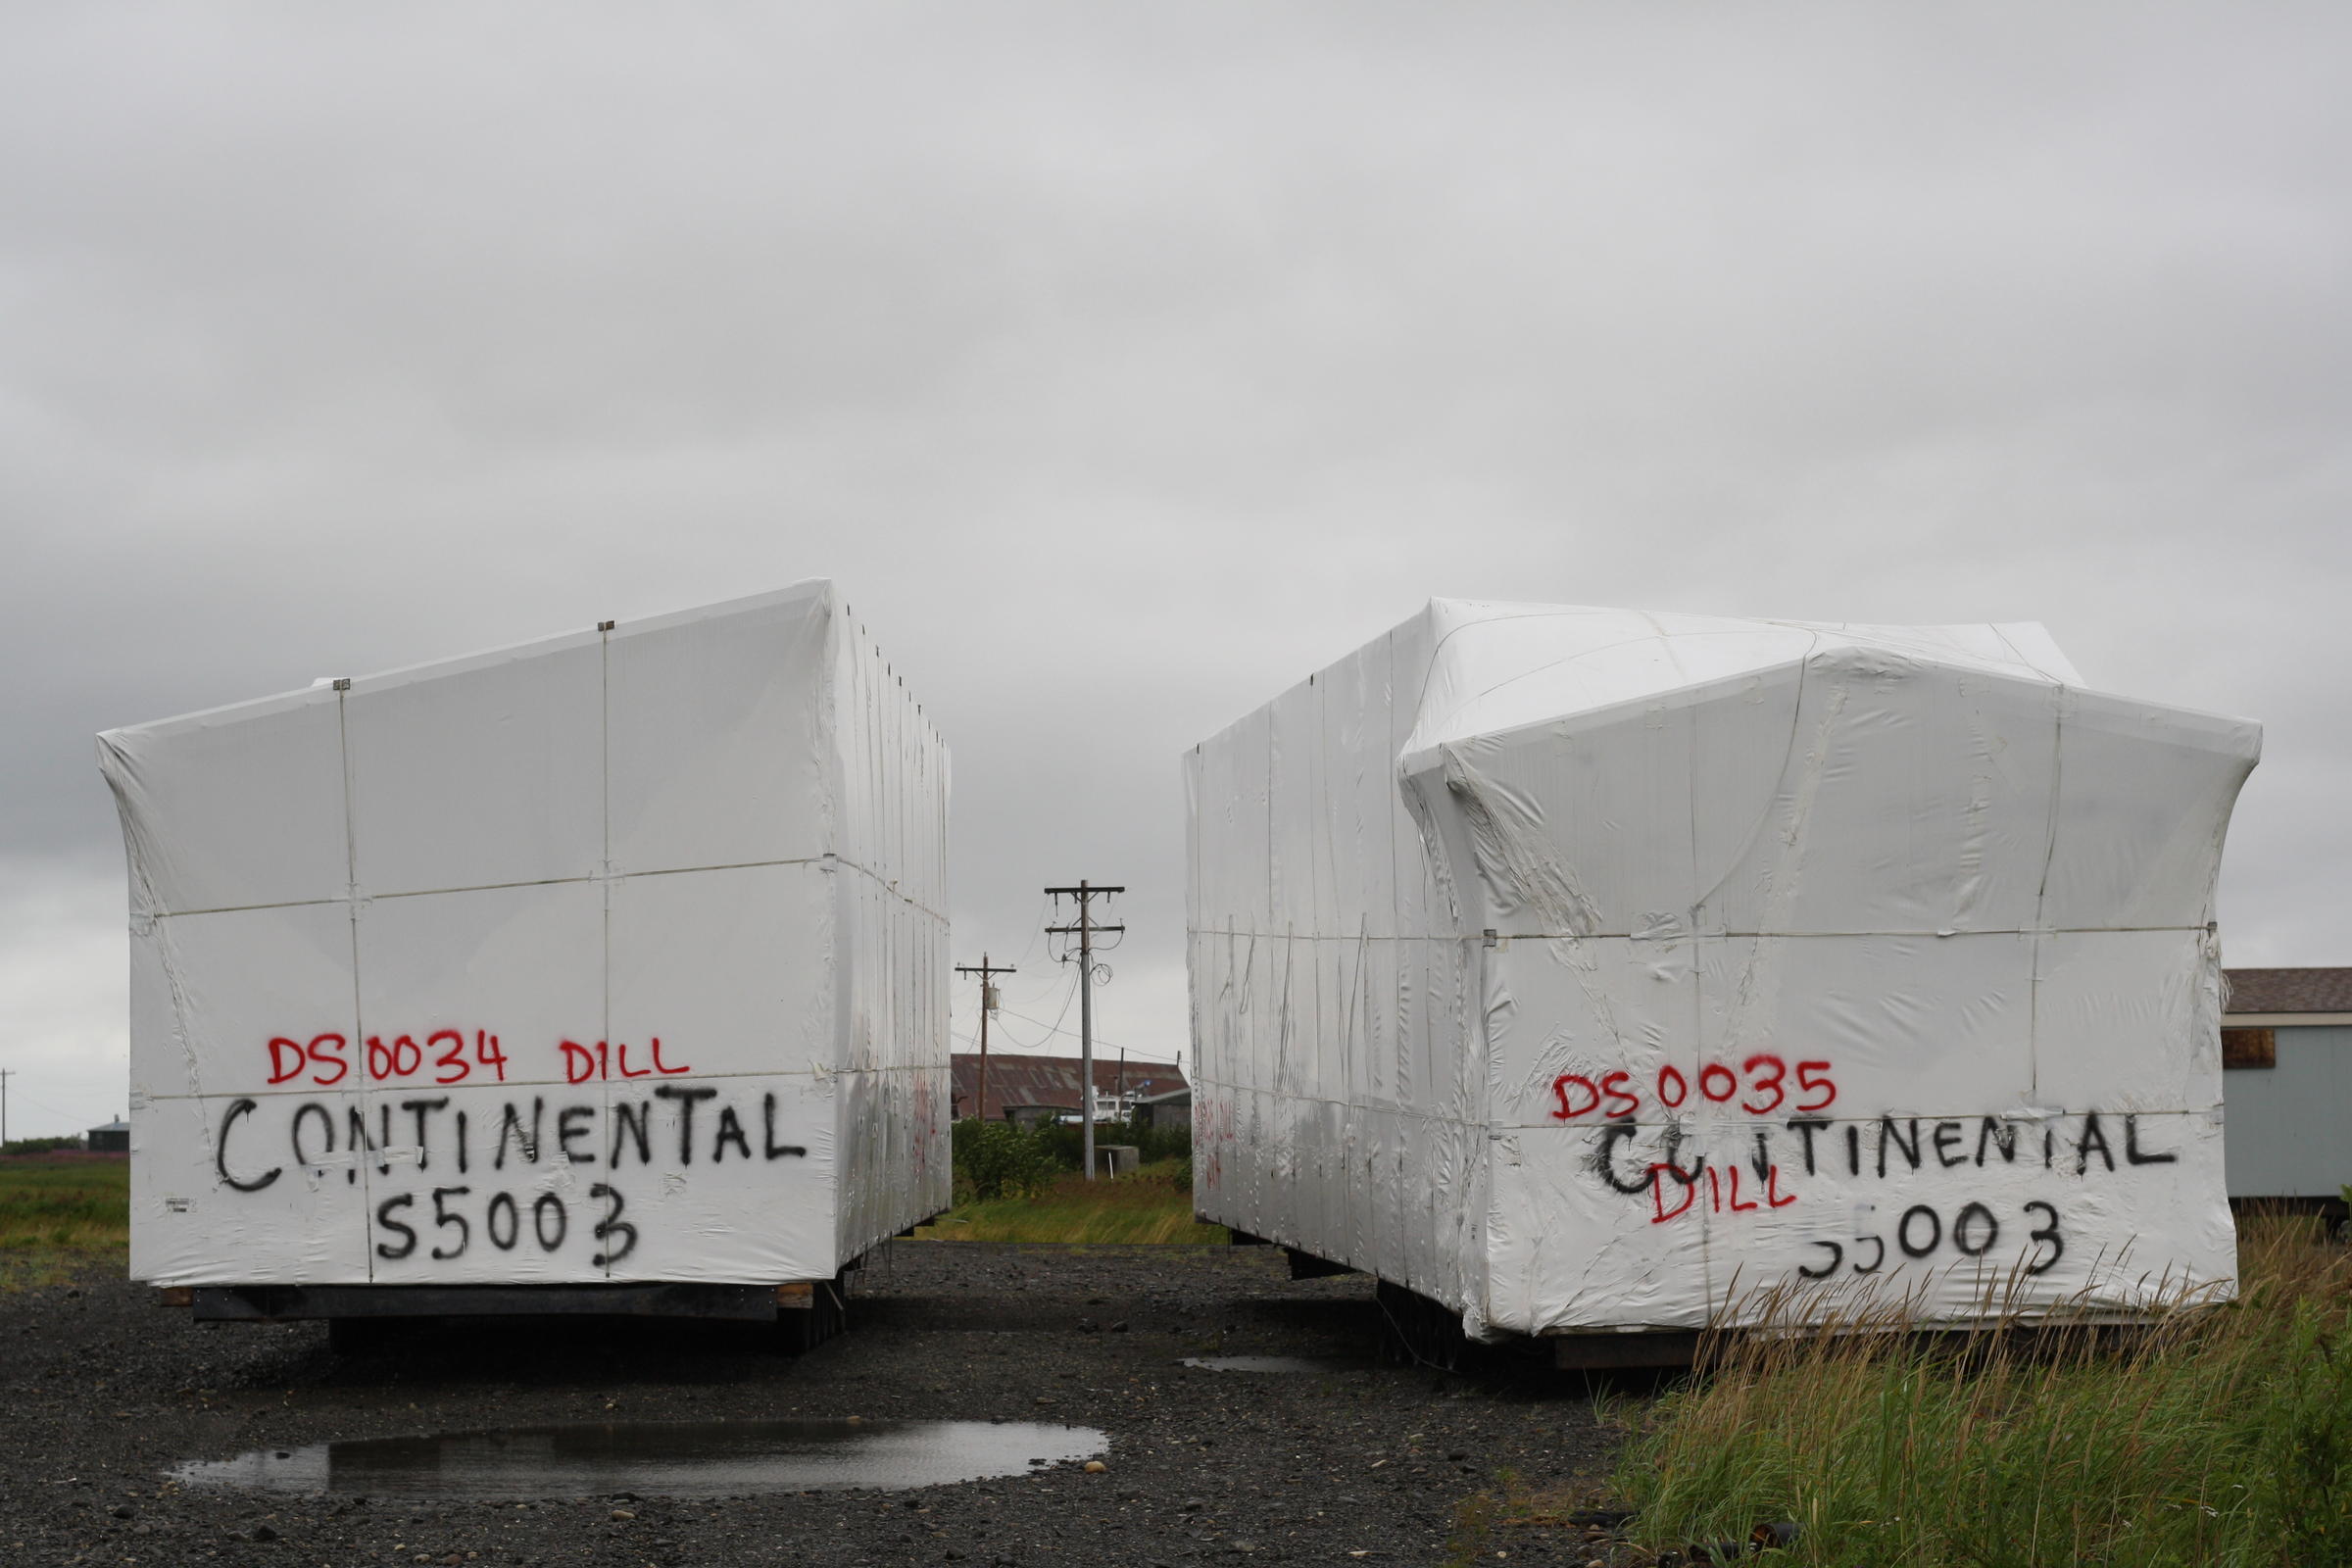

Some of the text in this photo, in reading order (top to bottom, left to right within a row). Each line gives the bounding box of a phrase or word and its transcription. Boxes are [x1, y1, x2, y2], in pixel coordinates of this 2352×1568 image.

[558, 1038, 691, 1086] DILL
[217, 1084, 808, 1194] CONTINENTAL
[376, 1184, 639, 1266] S5003
[1645, 1162, 1798, 1224] DILL
